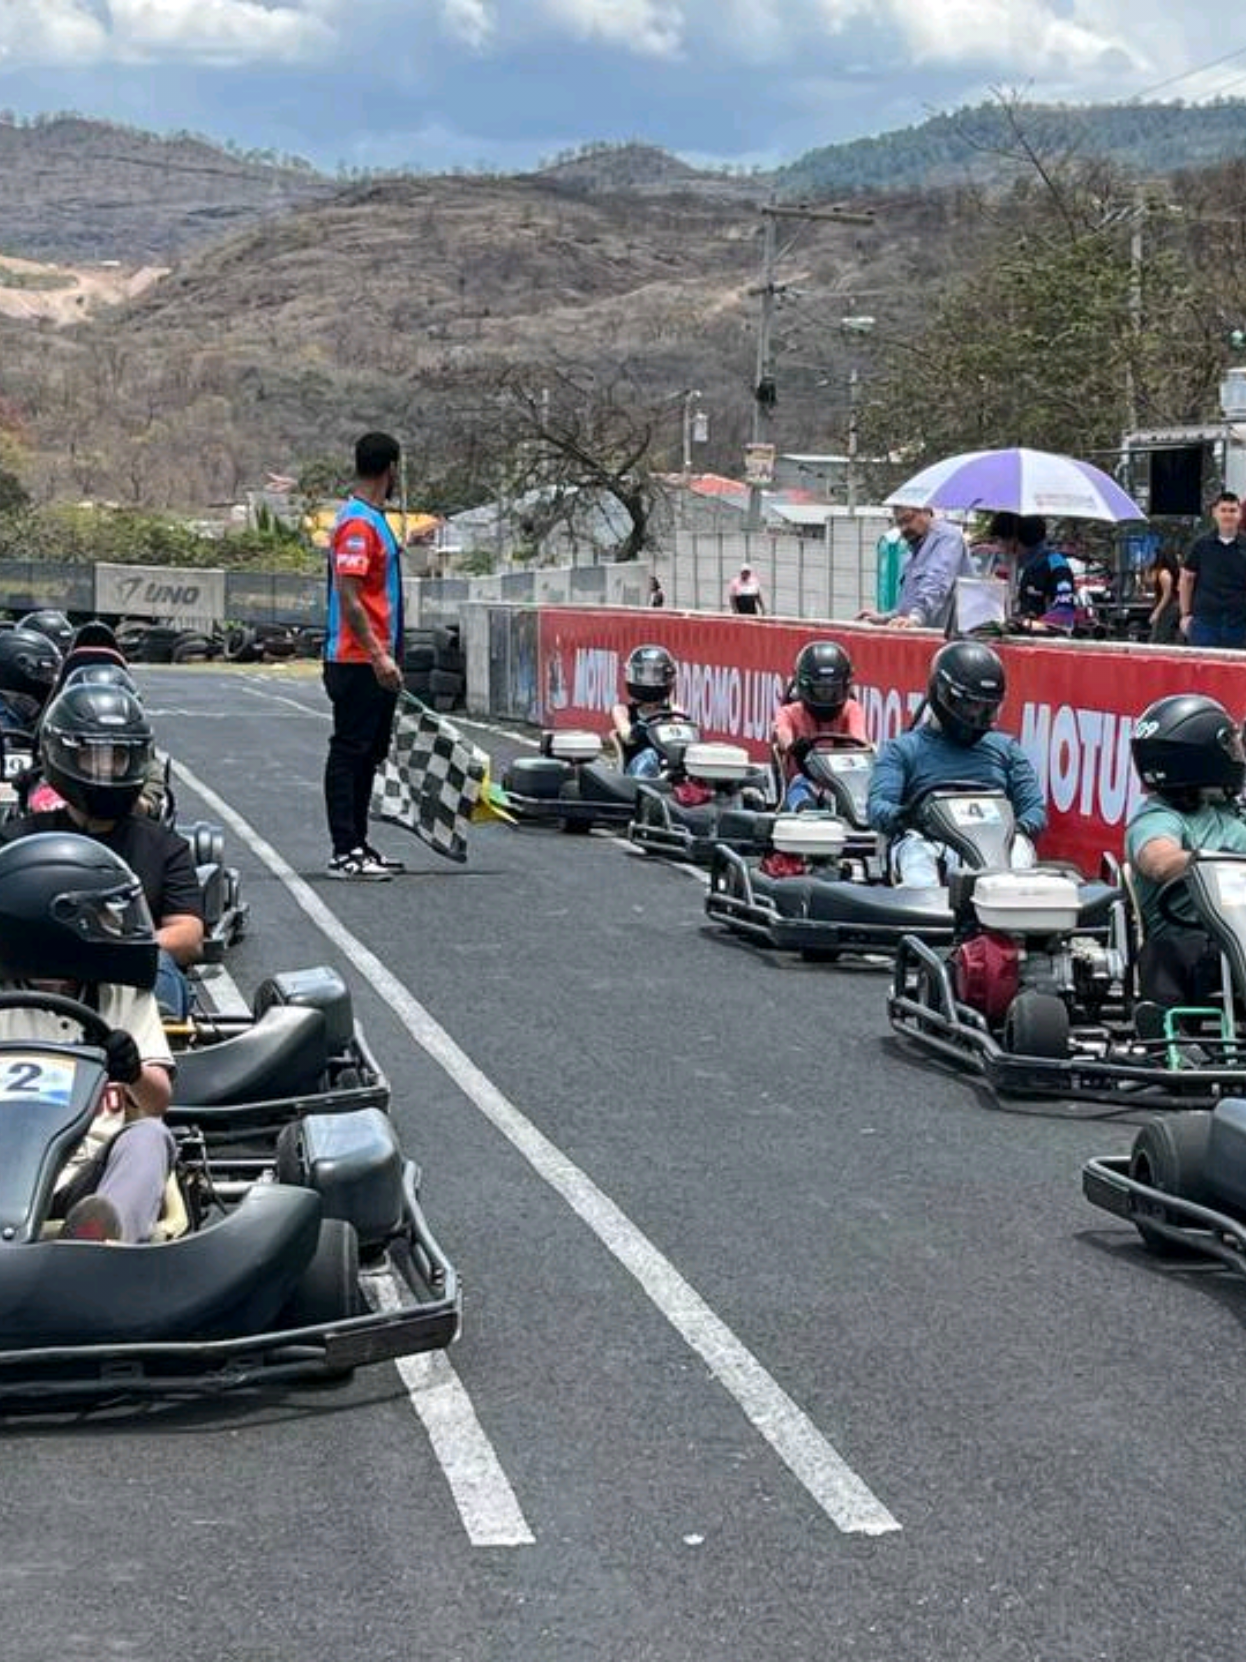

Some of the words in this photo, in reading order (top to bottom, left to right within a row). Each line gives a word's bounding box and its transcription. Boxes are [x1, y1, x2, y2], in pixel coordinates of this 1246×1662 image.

[144, 583, 200, 605] UNO
[572, 647, 619, 714] MOTUL
[669, 661, 741, 737] DROMO
[969, 802, 985, 819] 4
[5, 1061, 42, 1092] 2
